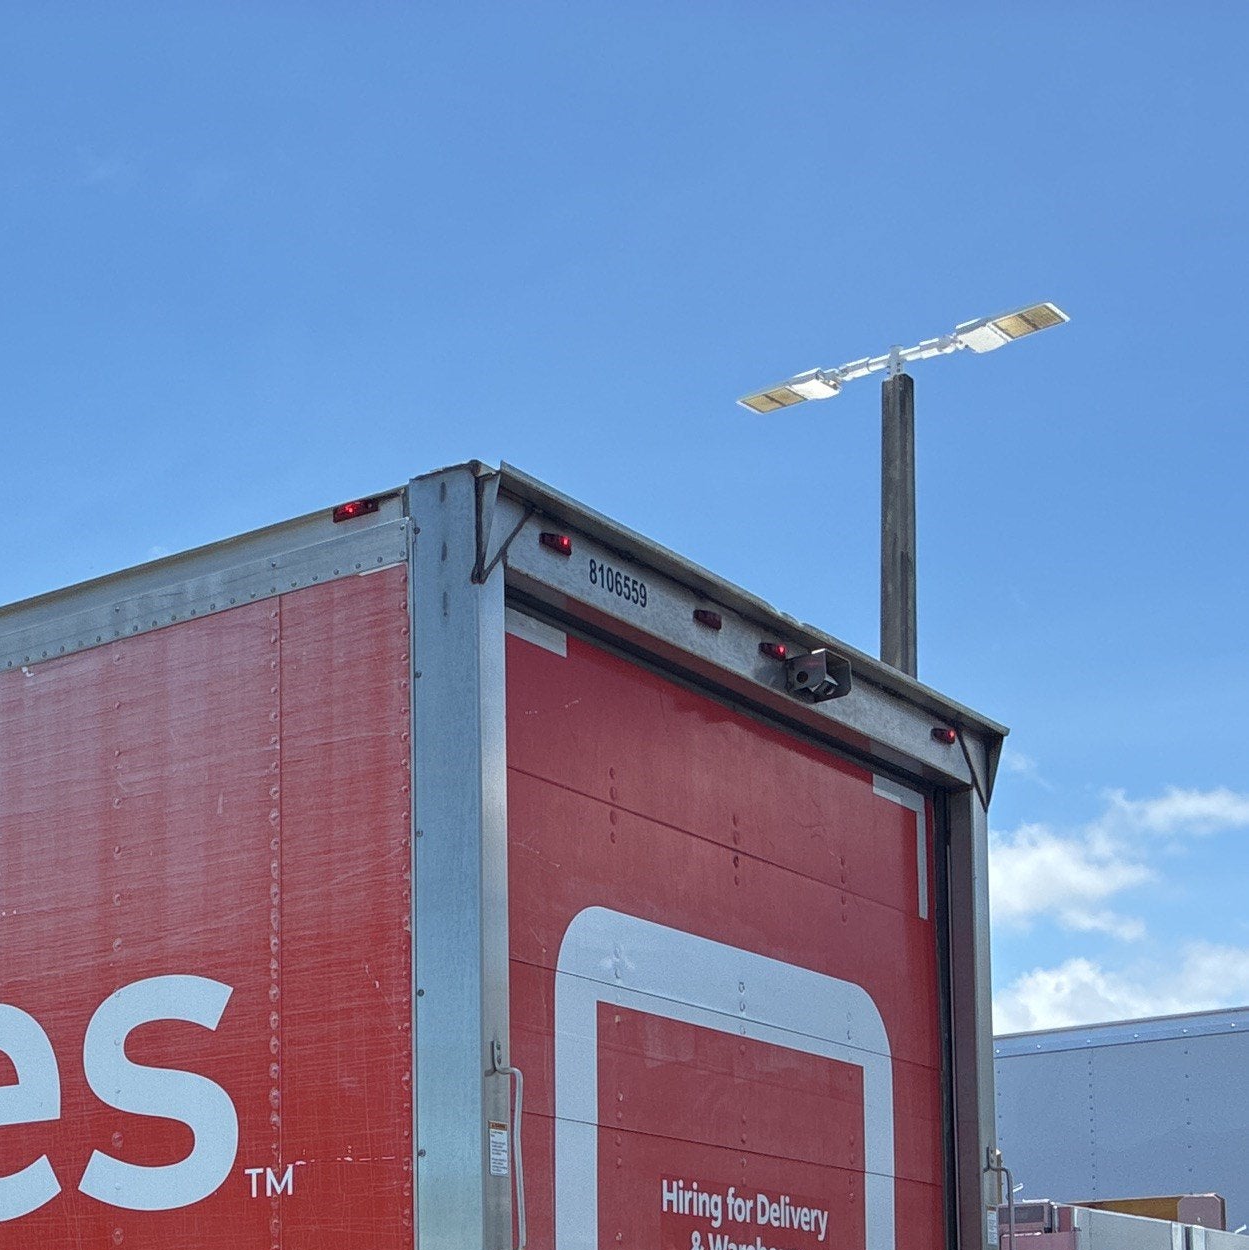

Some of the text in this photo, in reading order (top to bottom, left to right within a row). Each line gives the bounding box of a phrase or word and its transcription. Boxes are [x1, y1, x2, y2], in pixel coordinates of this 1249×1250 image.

[589, 558, 648, 608] 8106559
[244, 1164, 294, 1198] TM
[662, 1179, 829, 1241] Hiring for Delivery
